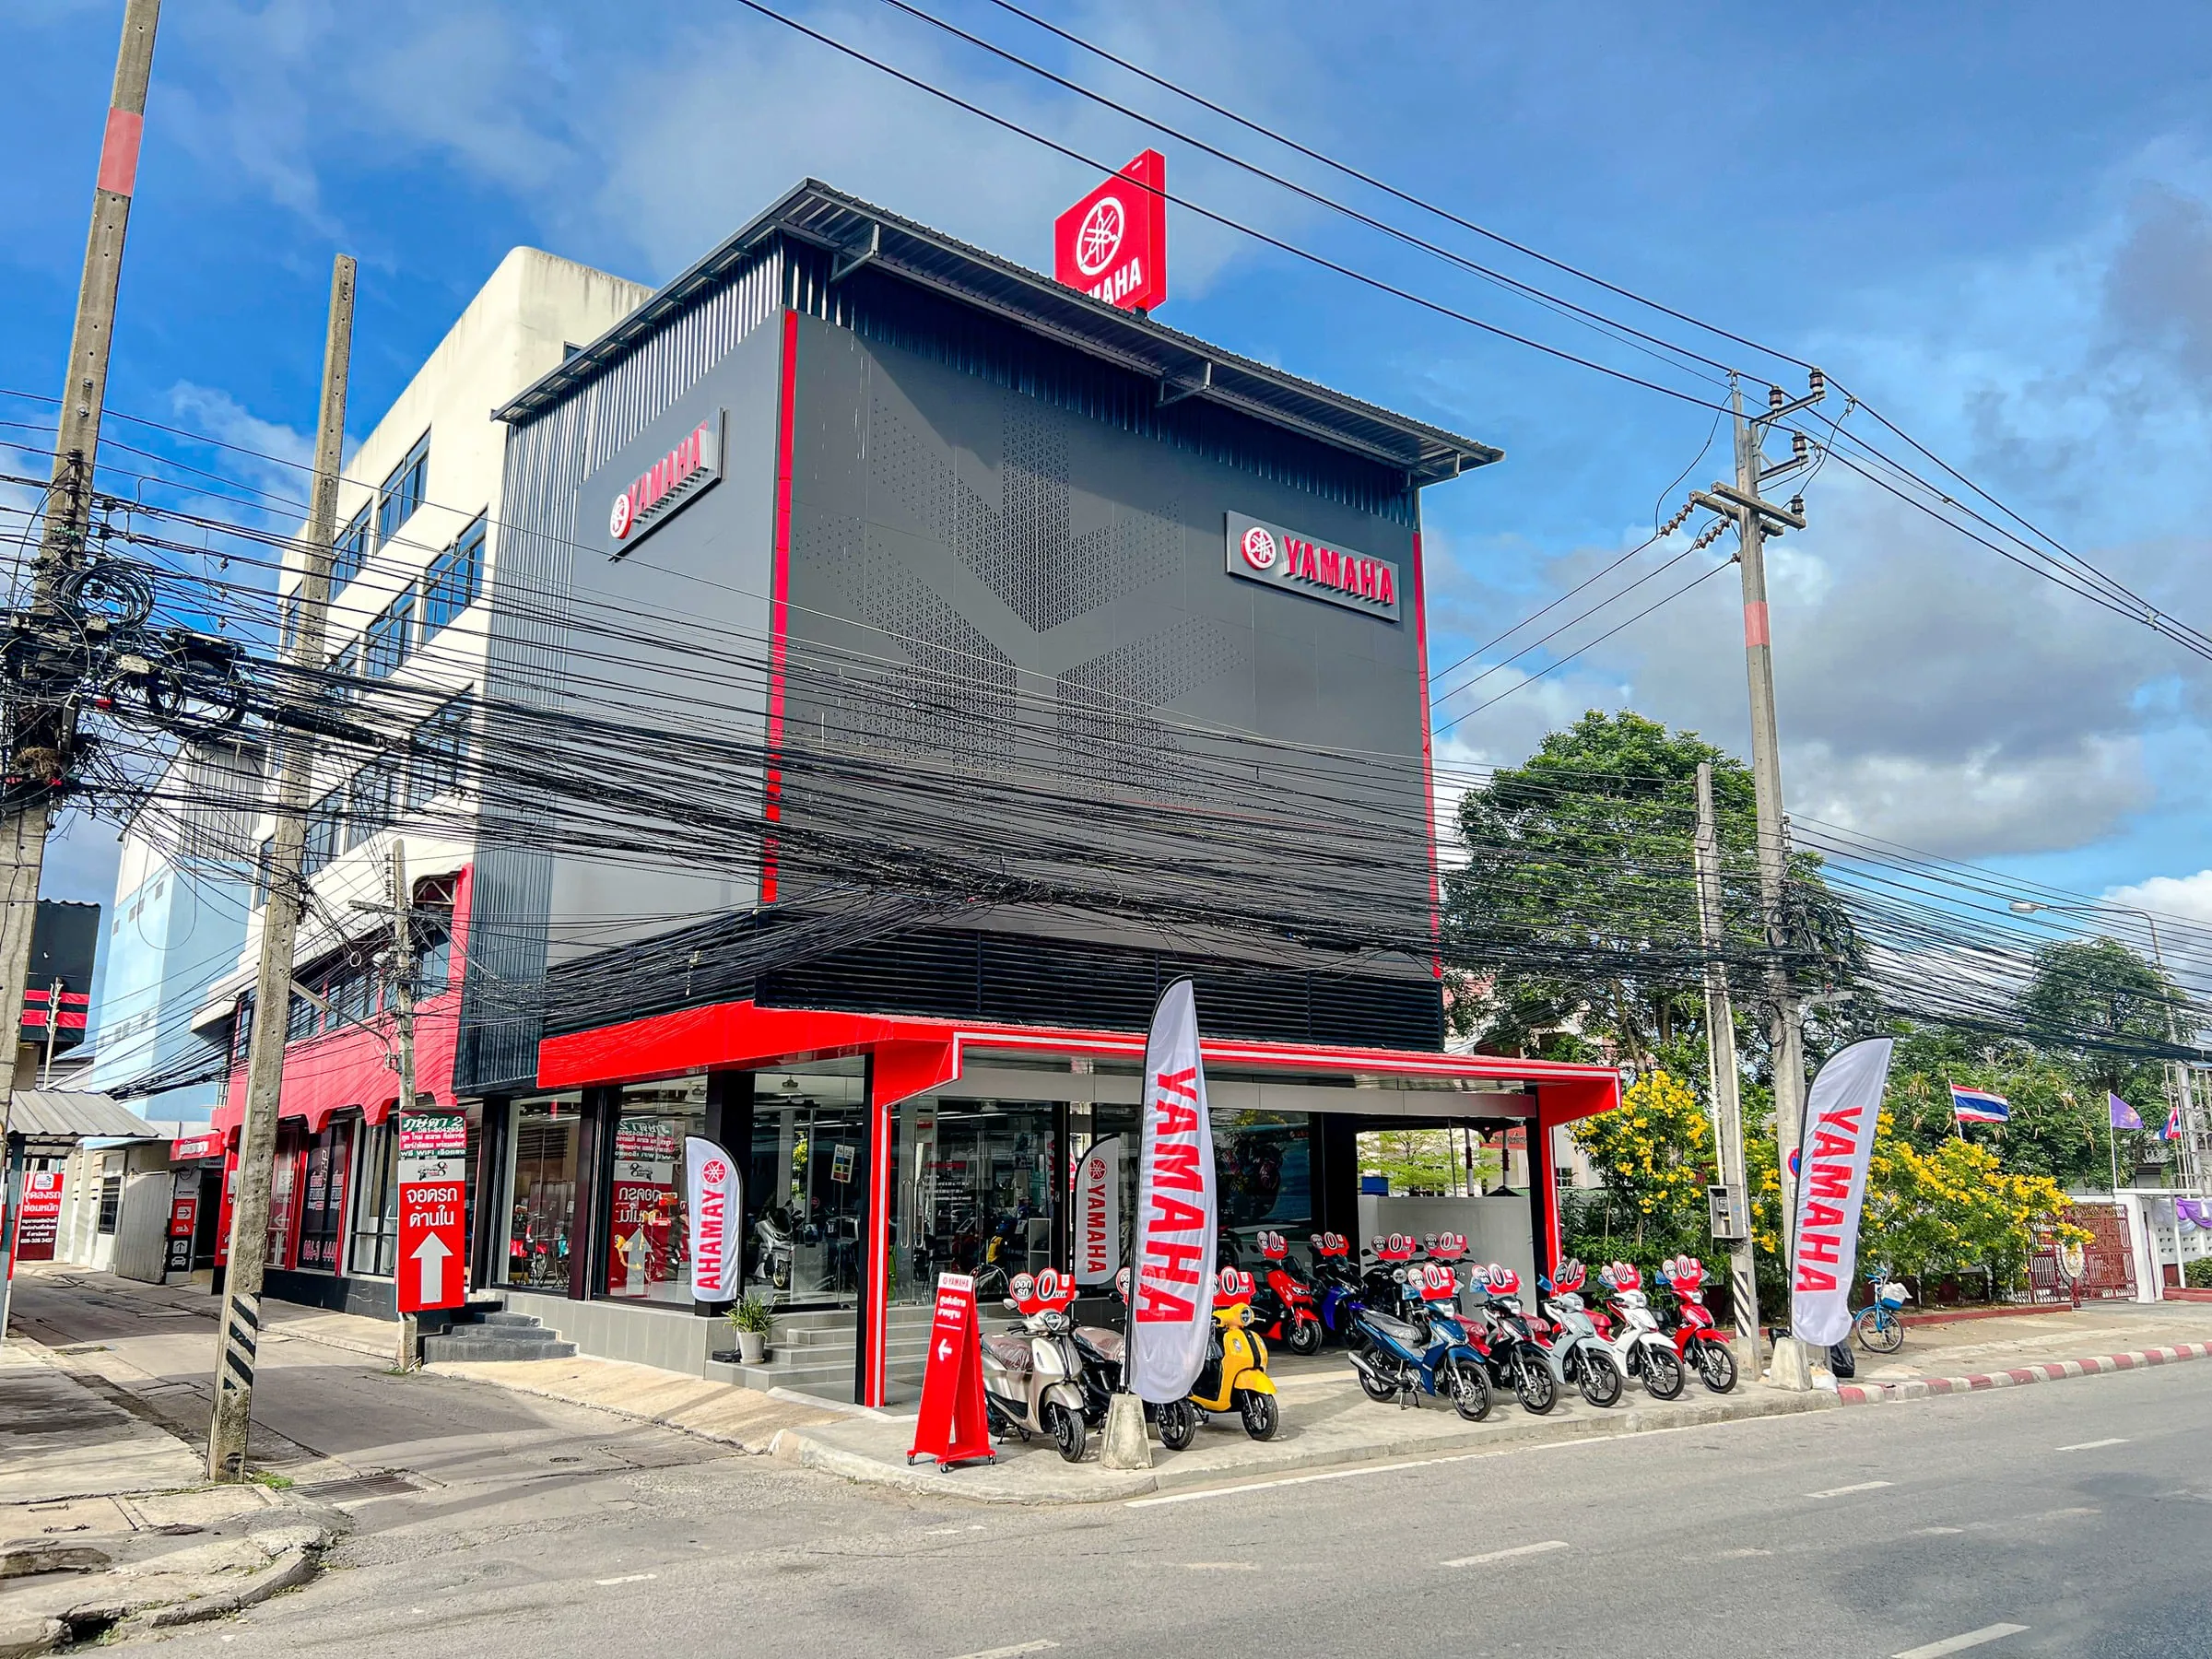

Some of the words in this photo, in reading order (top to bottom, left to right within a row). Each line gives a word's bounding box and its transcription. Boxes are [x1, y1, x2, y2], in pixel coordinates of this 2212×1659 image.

[629, 428, 709, 522] YAMAHA
[1282, 535, 1394, 606] YAMAHA
[451, 1116, 464, 1127] 2
[406, 1187, 458, 1204] จอดรถ
[1136, 1065, 1206, 1323] YAMAHA
[1794, 1106, 1864, 1293] YAMAHA
[409, 1205, 454, 1228] ด้านใน
[1087, 1183, 1106, 1274] YAMAHA
[948, 1277, 969, 1288] YAMAHA
[1037, 1269, 1058, 1301] 0
[1221, 1267, 1238, 1296] 0
